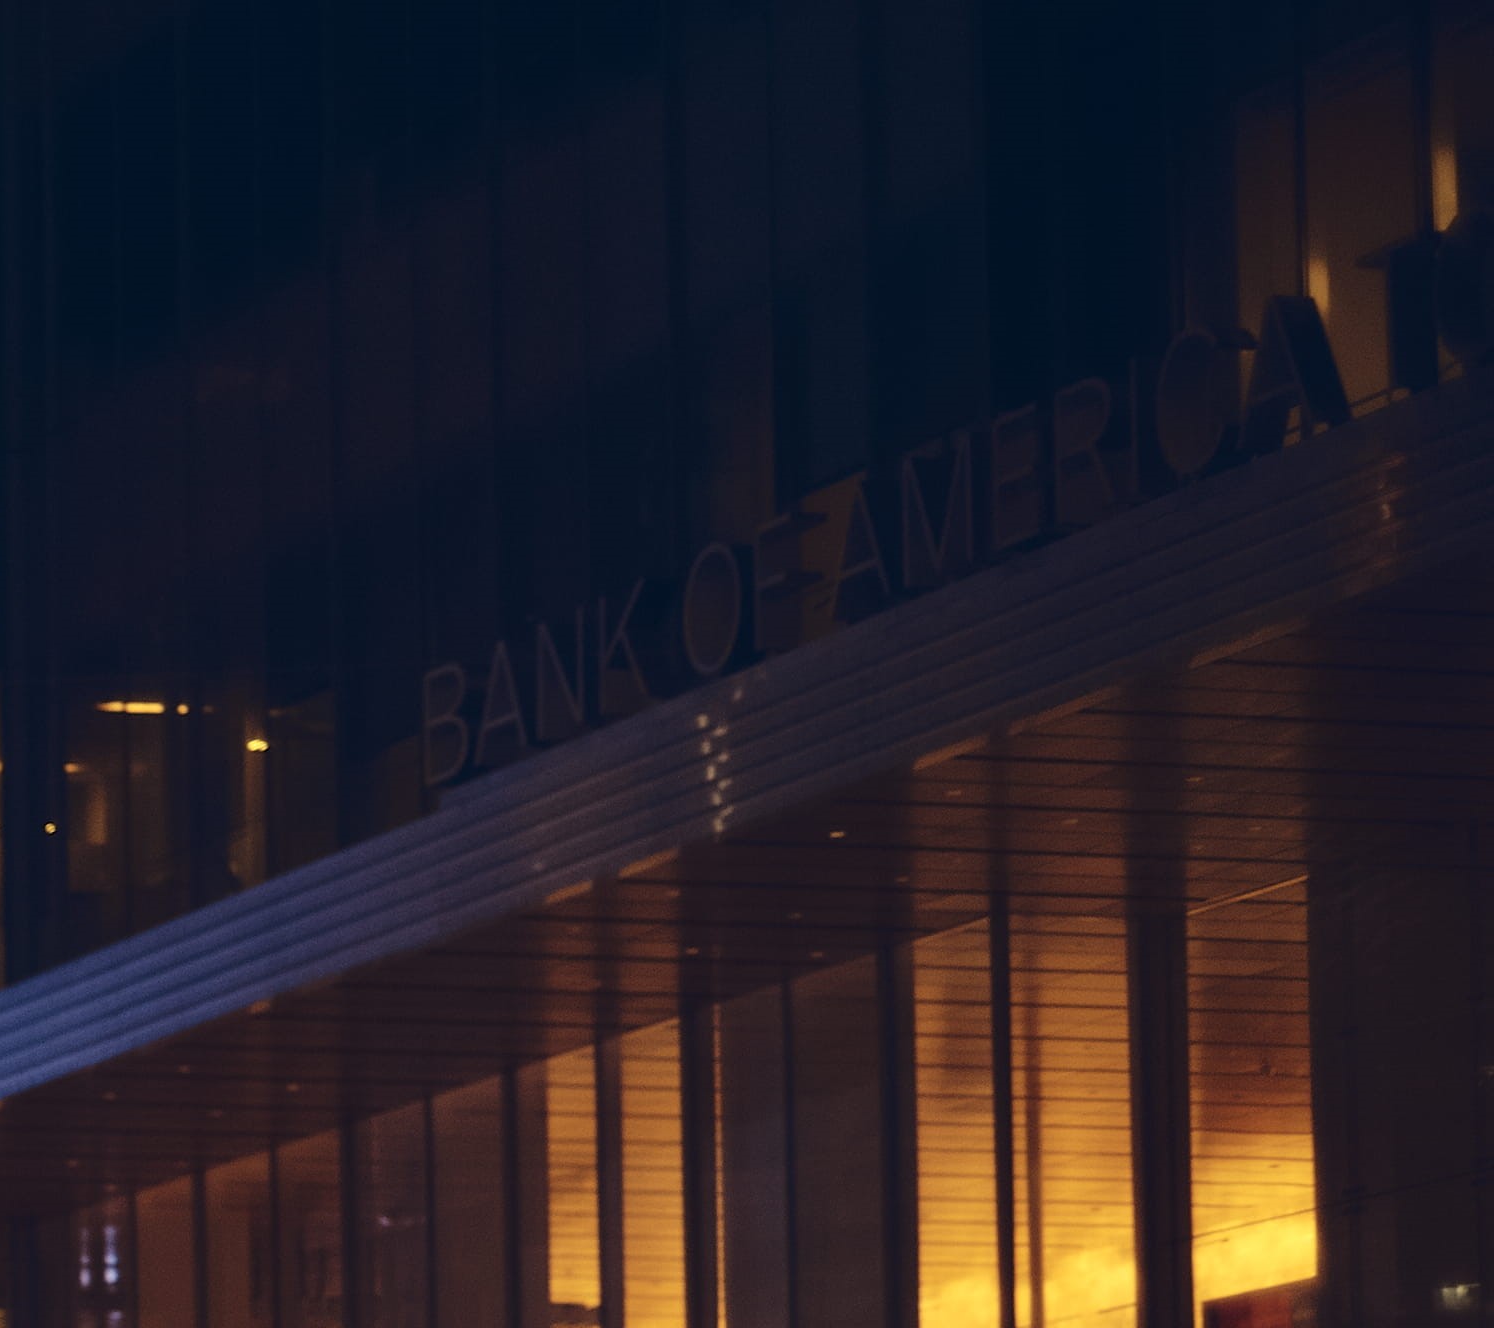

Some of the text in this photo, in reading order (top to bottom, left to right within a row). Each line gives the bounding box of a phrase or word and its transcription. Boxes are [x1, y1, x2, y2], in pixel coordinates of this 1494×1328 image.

[422, 575, 652, 788] BANK
[682, 508, 814, 676] OF
[832, 294, 1350, 626] AMERICA
